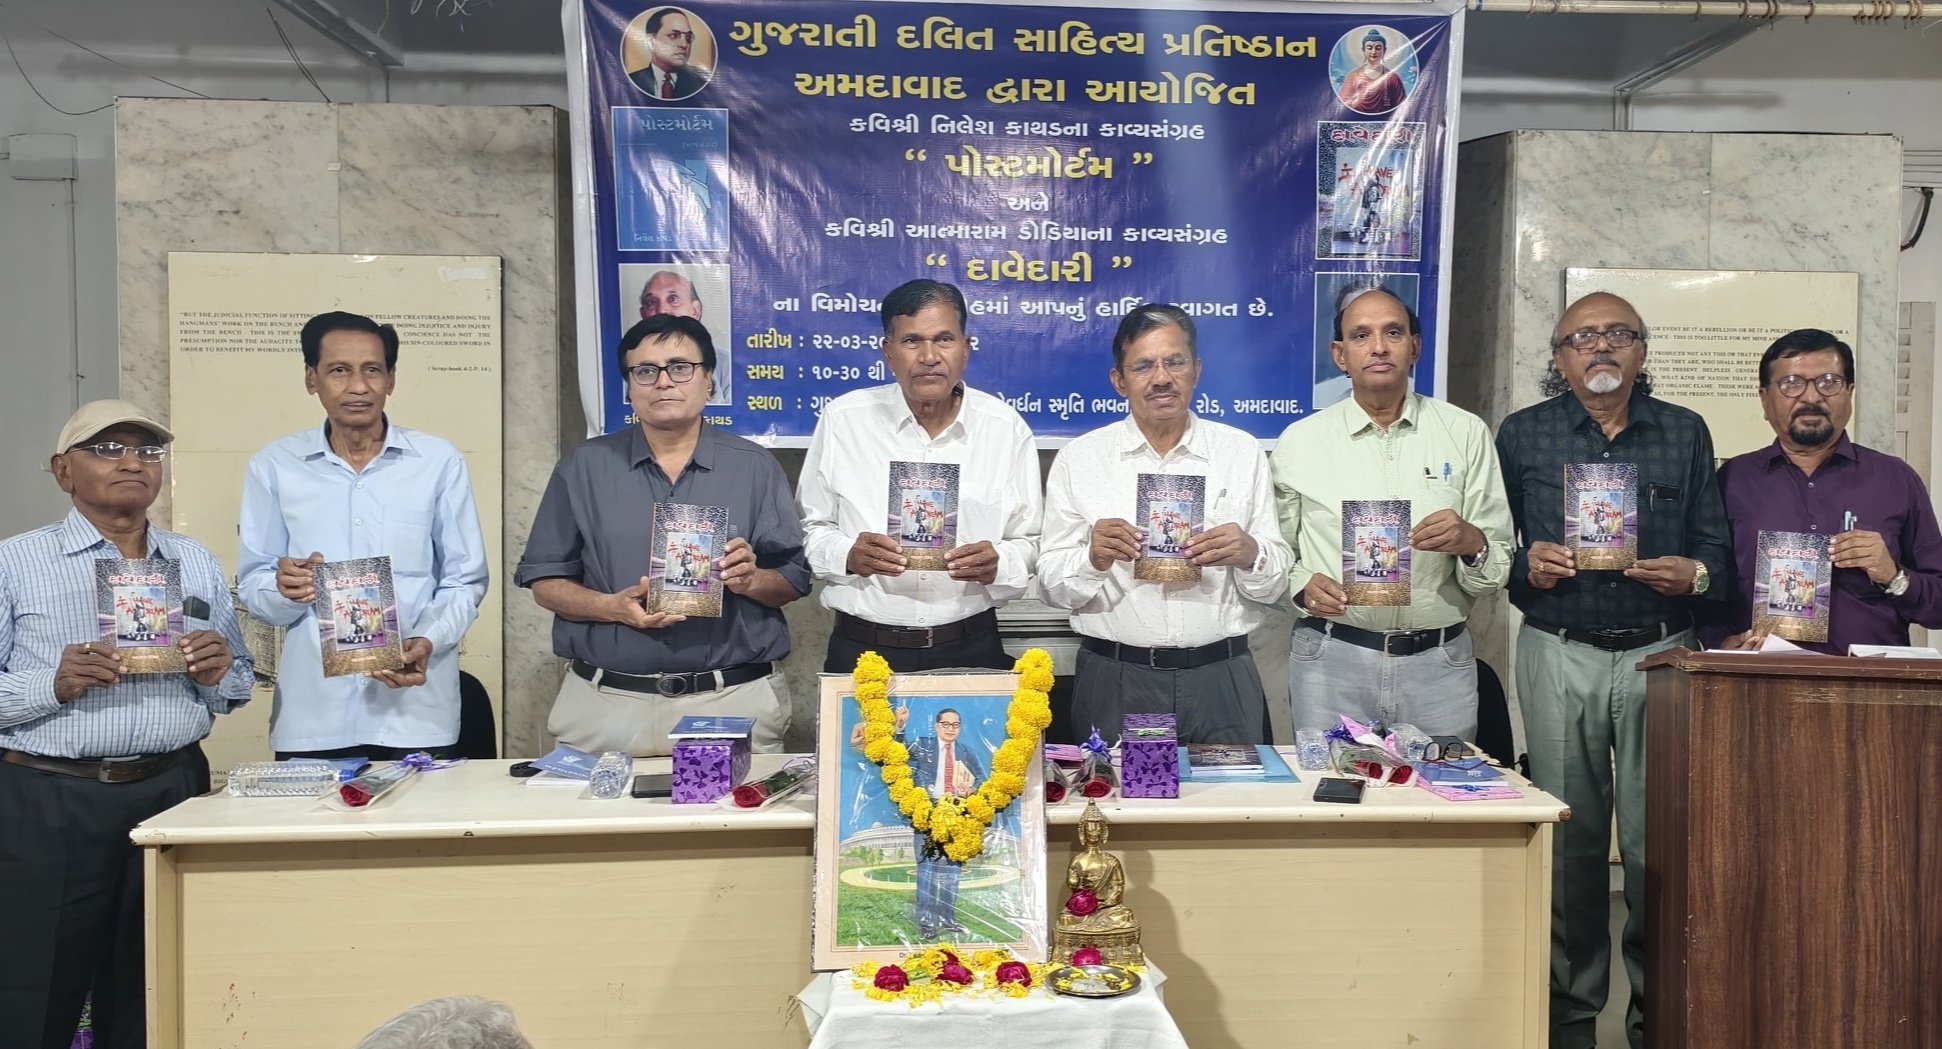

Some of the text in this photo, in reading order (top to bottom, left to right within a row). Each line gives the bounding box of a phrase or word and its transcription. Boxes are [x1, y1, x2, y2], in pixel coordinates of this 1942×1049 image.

[728, 14, 1317, 58] ગુજરાતી દલિત સાહિત્ય પ્રતિષ્ઠાન
[794, 71, 1256, 105] અમદાવાદ દ્વારા આયોજિત
[849, 112, 1206, 141] કવિશ્રી નિલેશ કાથડના કાવ્યસંગ્રહ
[944, 145, 1114, 179] પોસ્ટમોર્ટમ
[1007, 192, 1050, 212] અને
[824, 217, 1229, 246] કવિશ્રી આત્મારામ ડોડિયાના કાવ્યસંગ્રહ
[966, 251, 1094, 283] દાવેદારી
[772, 296, 800, 312] ના
[1020, 299, 1087, 322] આપનું
[746, 328, 793, 350] તારીખ
[746, 364, 785, 381] સમય
[812, 366, 861, 381] ૧૦-૩૦
[867, 360, 886, 382] થી
[746, 396, 783, 411] સ્થળ
